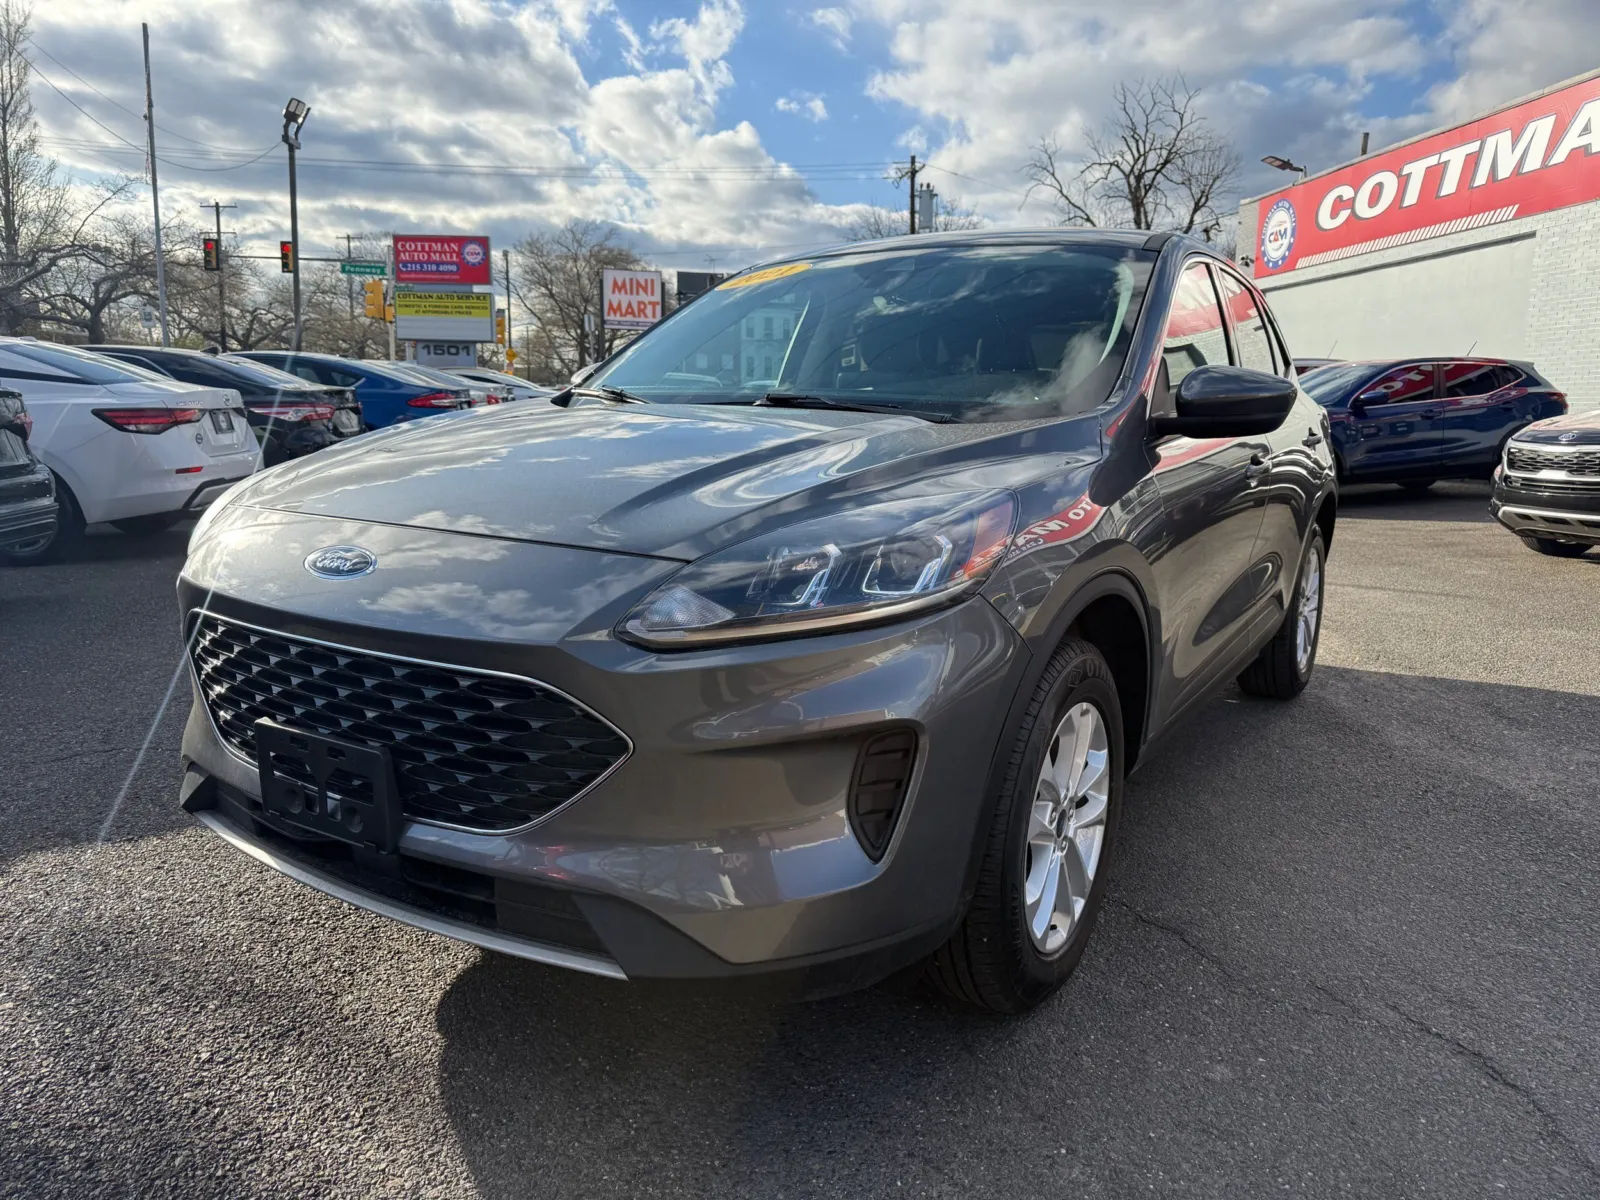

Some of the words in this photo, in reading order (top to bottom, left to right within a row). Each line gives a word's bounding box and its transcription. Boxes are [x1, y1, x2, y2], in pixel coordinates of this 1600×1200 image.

[1268, 227, 1288, 244] CAM
[397, 241, 459, 252] COTTMAN
[399, 252, 428, 261] AUTO
[430, 252, 460, 262] MALL
[345, 265, 382, 274] Pennway
[407, 263, 421, 271] 215
[422, 263, 437, 272] 310
[438, 264, 458, 272] 4090
[611, 275, 655, 297] MINI
[456, 294, 488, 302] SERVICE
[606, 299, 661, 320] MART
[422, 344, 471, 356] 1501
